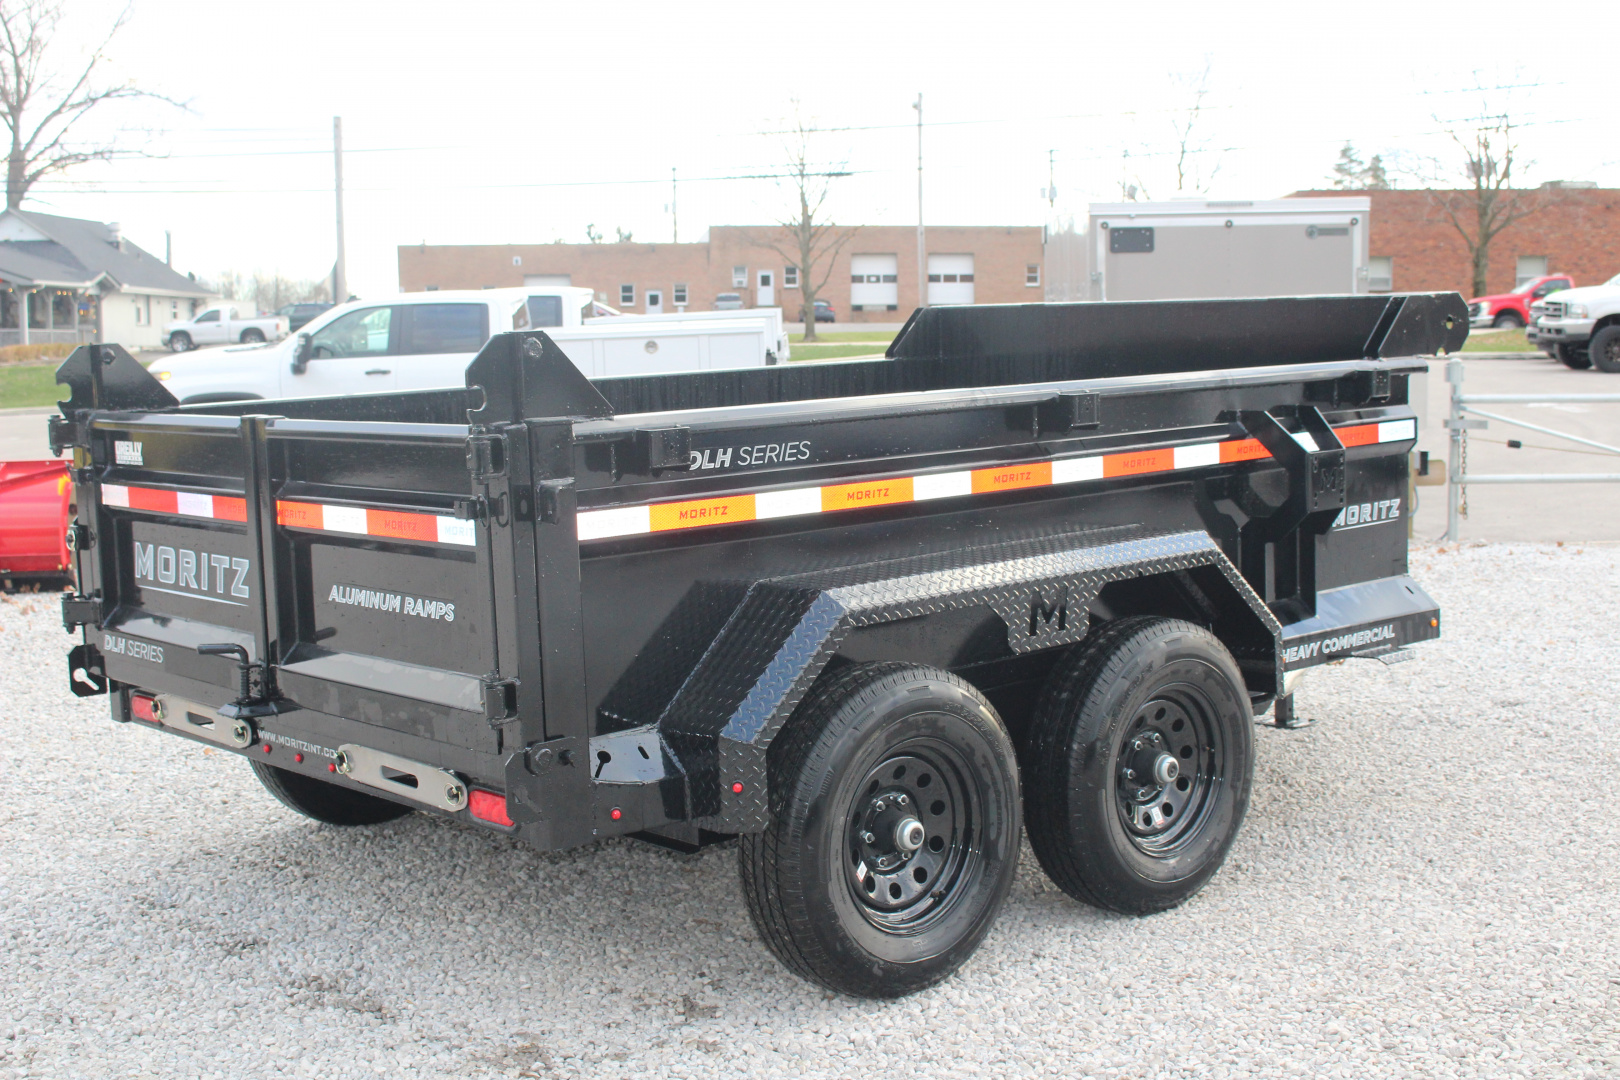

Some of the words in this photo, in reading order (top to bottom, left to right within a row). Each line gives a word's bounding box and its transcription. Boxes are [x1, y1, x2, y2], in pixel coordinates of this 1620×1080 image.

[689, 447, 733, 471] DLH
[737, 440, 811, 466] SERIES
[1122, 457, 1157, 469] MORITZ
[993, 471, 1032, 485] MORITZ
[847, 487, 890, 502] MORITZ
[384, 519, 418, 533] MORITZ
[679, 505, 729, 520] MORITZ
[1332, 498, 1401, 528] MORITZ
[134, 541, 250, 599] MORITZ
[328, 584, 402, 613] ALUMINUM
[403, 596, 455, 622] RAMPS
[104, 634, 126, 654] DLH
[127, 639, 164, 664] SERIES
[1282, 641, 1322, 663] HEAVY
[1321, 624, 1396, 654] COMMERCIAL
[257, 728, 338, 760] WWW.MORITZINT.CO
